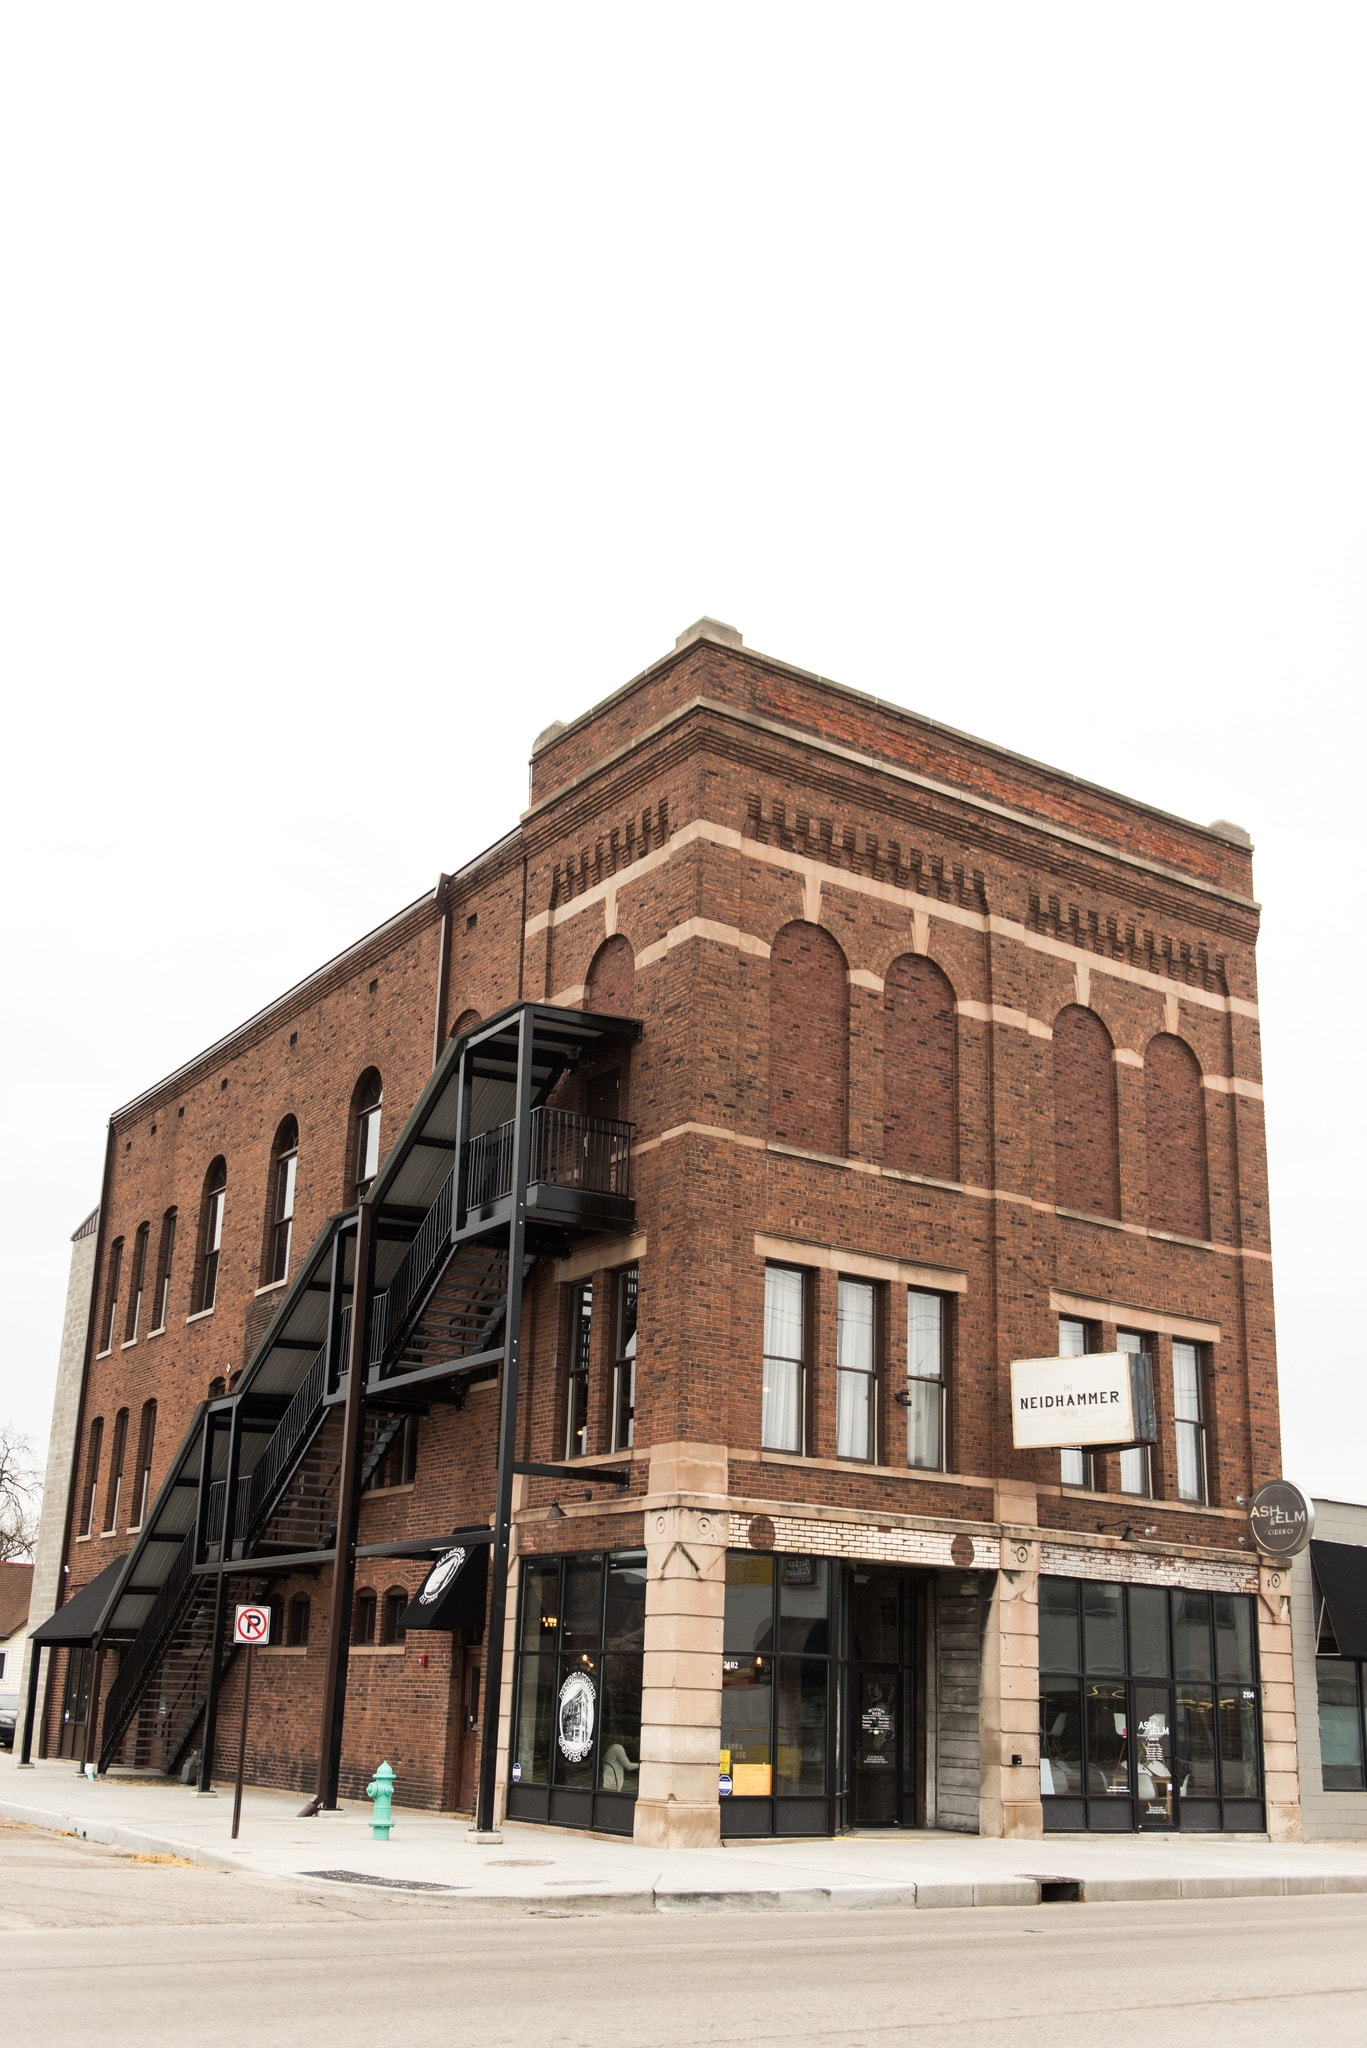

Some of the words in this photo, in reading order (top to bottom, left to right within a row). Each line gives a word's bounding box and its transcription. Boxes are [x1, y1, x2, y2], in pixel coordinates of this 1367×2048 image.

[1020, 1391, 1120, 1410] NEIDHAMMER
[1250, 1505, 1280, 1518] ASH
[1269, 1517, 1275, 1525] &
[1275, 1511, 1305, 1523] ELM
[247, 1614, 262, 1634] P
[723, 1660, 739, 1669] 2102
[1242, 1691, 1255, 1699] 2104
[1138, 1721, 1156, 1730] ASH
[1152, 1726, 1170, 1736] ELM
[735, 1751, 747, 1759] JOE
